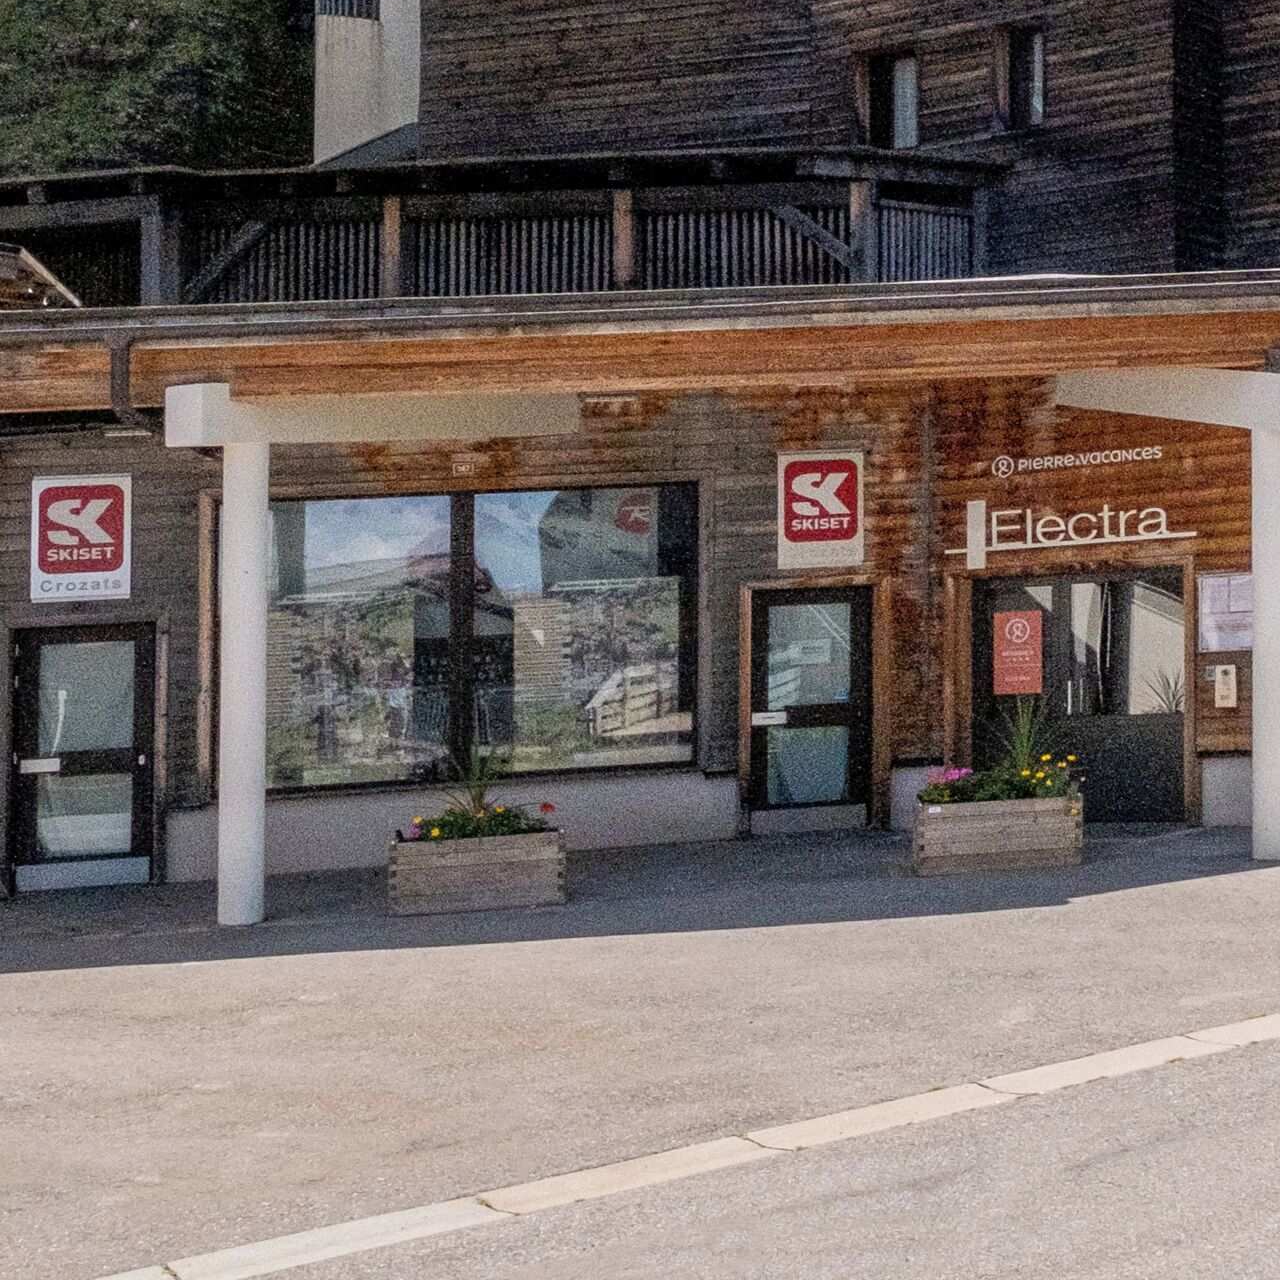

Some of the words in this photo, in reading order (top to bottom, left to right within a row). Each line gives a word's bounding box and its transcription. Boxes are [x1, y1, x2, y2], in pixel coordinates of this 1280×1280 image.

[791, 517, 851, 531] SKISET
[991, 504, 1167, 548] Electra
[46, 546, 114, 561] SKISET
[40, 579, 122, 593] Crozats
